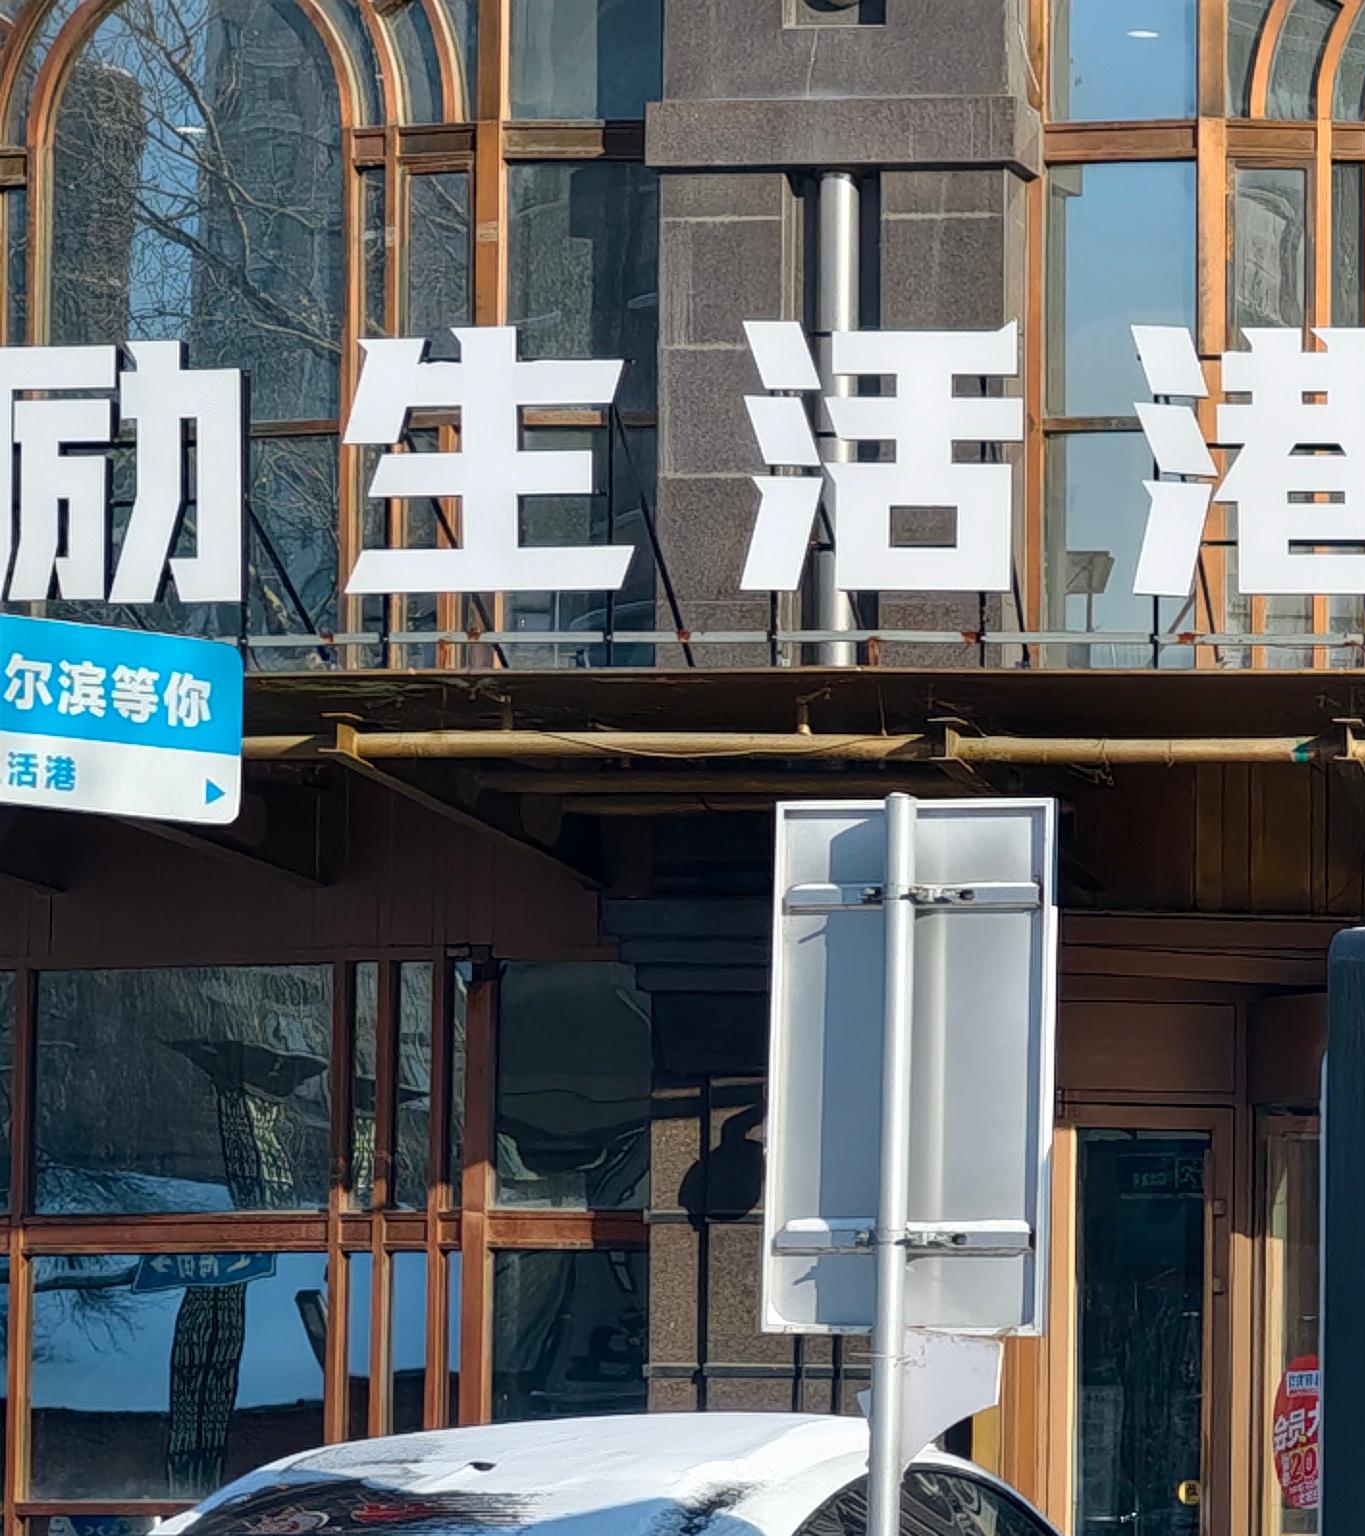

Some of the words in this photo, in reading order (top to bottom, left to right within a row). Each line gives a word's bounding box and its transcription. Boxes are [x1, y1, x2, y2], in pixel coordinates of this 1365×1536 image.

[4, 652, 212, 728] 尔滨等你
[7, 751, 76, 792] 活港
